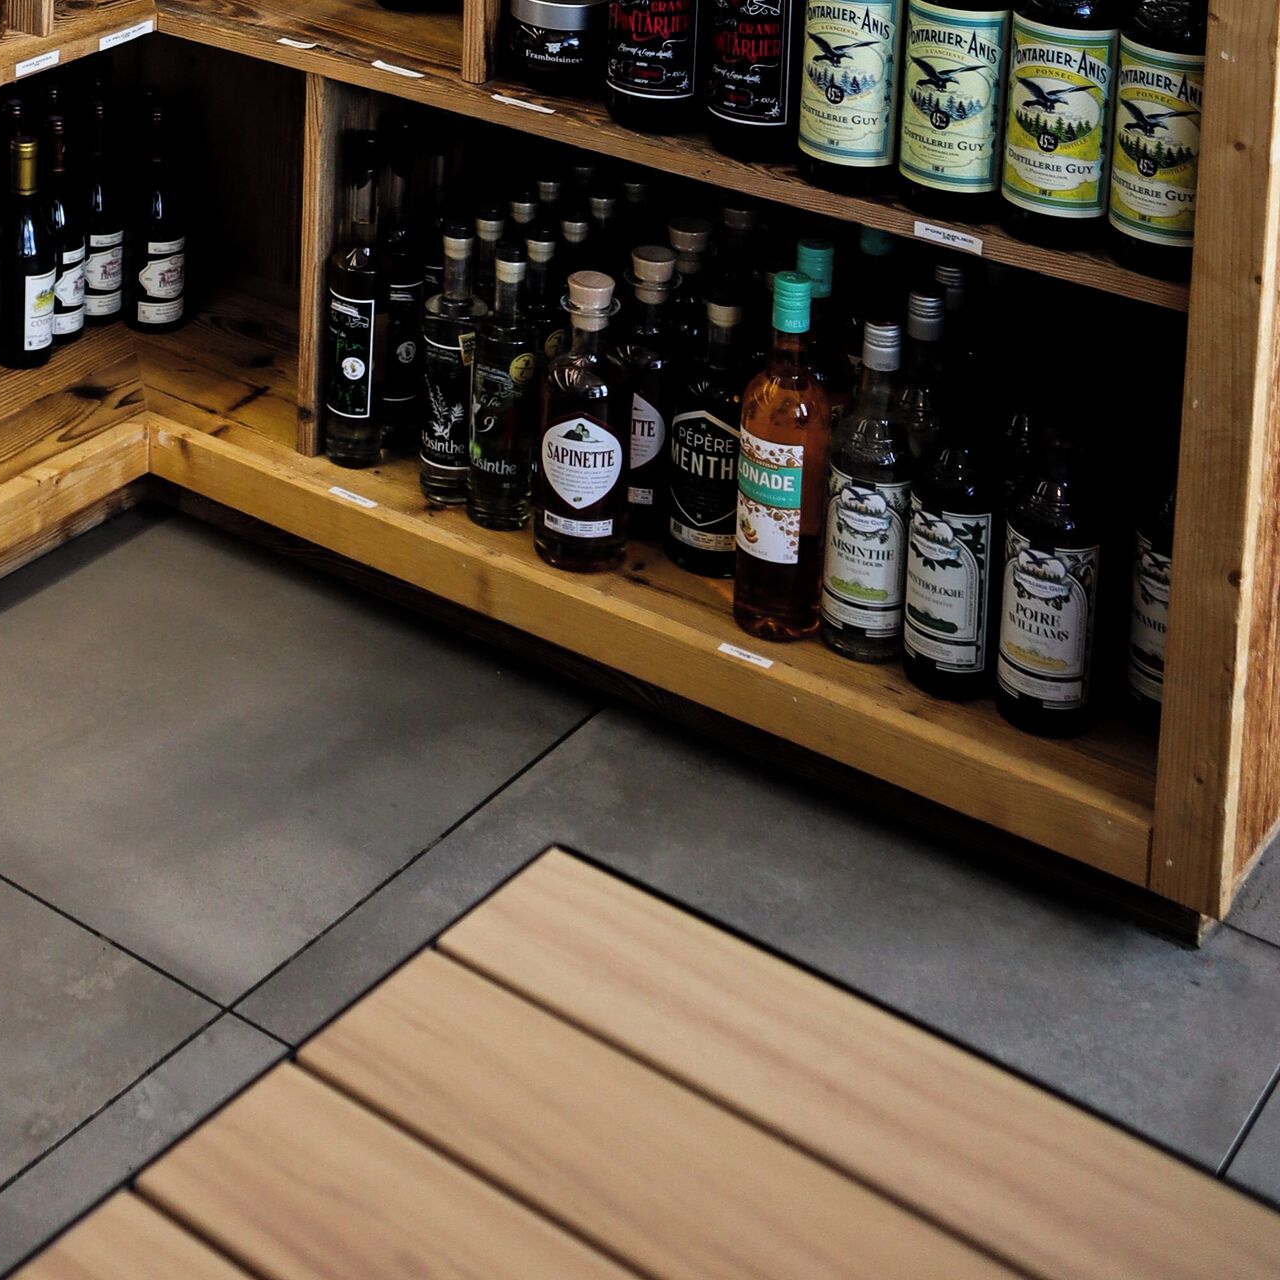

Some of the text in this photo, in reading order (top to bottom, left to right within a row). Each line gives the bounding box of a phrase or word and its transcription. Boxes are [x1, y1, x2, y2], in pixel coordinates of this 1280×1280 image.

[1013, 36, 1108, 84] PONTARLIER-ANIS
[1035, 67, 1075, 82] PONSEC
[1135, 90, 1174, 105] PONSEC
[801, 99, 880, 126] DISTILLERIE GUY
[903, 125, 986, 152] DISTILLERIE GUY
[1008, 147, 1095, 175] DISTILLERIE GUY
[1111, 171, 1197, 203] DISTILLERIE GUY
[678, 426, 735, 454] PÉPÈRE
[546, 441, 616, 469] SAPINETTE
[830, 534, 895, 562] ABSINTHE
[1008, 611, 1070, 643] WILLIAMS
[1015, 601, 1062, 629] POIRE
